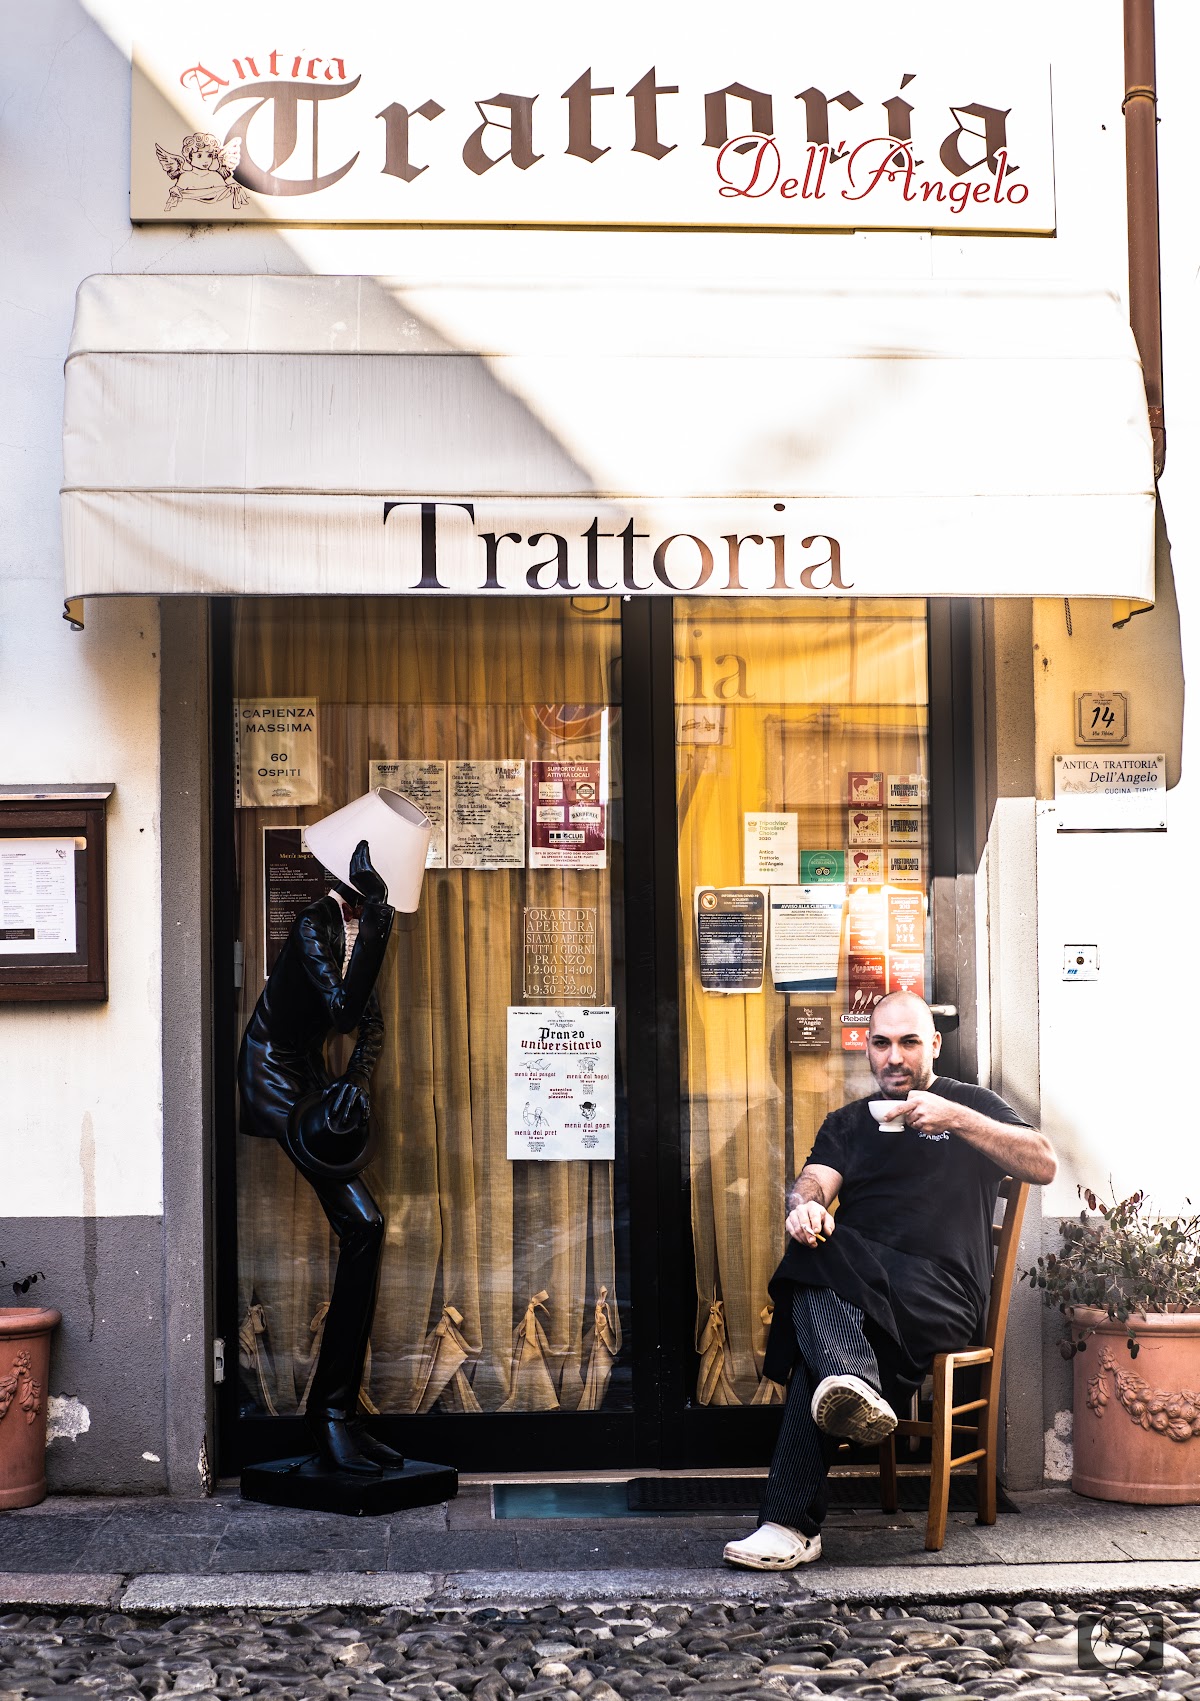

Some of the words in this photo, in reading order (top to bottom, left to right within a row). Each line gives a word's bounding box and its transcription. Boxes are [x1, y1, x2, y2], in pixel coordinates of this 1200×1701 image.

[180, 49, 347, 103] Antica
[212, 64, 1018, 196] Trattoria
[717, 133, 1029, 213] Dell'Angelo
[383, 502, 854, 591] Trattoria
[242, 709, 315, 718] CAPIENZA
[1091, 706, 1115, 729] 14
[246, 724, 312, 732] MASSIMA
[271, 753, 288, 762] 60
[1062, 761, 1099, 770] ANTICA
[1104, 760, 1158, 769] TRATTORIA
[1089, 772, 1158, 785] Dell'Angelo
[530, 910, 571, 920] ORARI
[576, 910, 590, 920] DI
[526, 921, 594, 932] APERTURA
[526, 934, 558, 944] SIAMO
[525, 944, 553, 954] TUTTI
[560, 944, 595, 954] GIORNI
[535, 955, 586, 964] PRANZO
[528, 965, 556, 974] 12:00
[564, 965, 593, 974] 14:00
[543, 975, 576, 985] CENA
[528, 985, 556, 994] 19:30
[564, 985, 593, 994] 22:00
[538, 1027, 585, 1041] Pranzo
[521, 1039, 602, 1051] universitario
